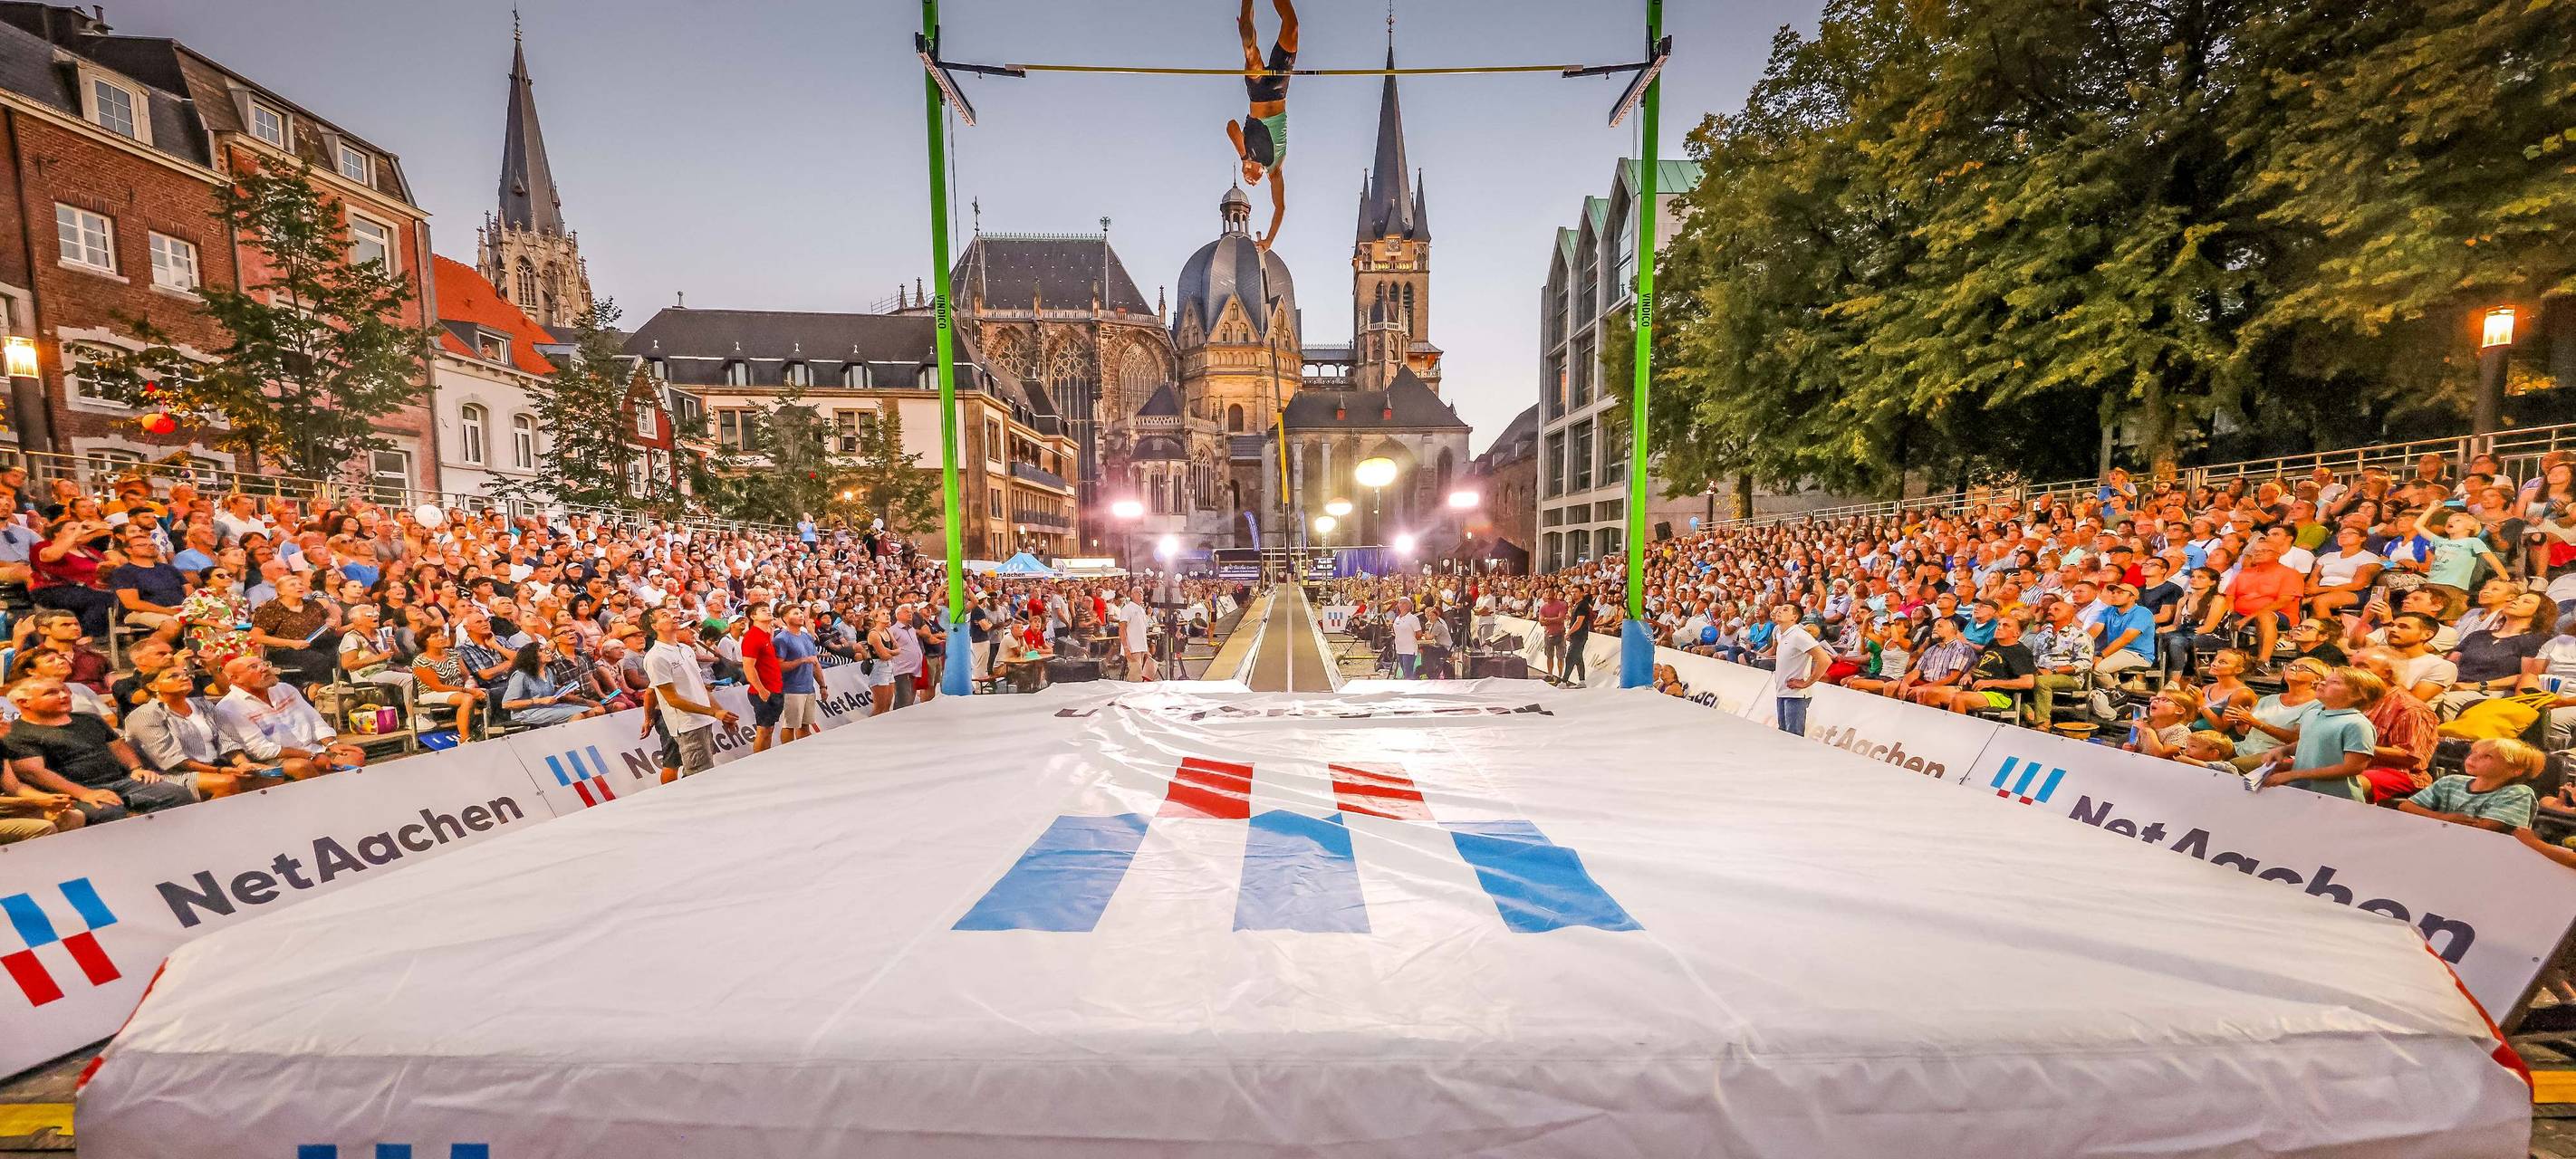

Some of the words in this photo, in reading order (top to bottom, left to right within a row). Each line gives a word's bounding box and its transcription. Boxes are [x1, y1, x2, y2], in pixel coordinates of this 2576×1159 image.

[937, 294, 947, 330] VINDICO
[1642, 292, 1651, 327] VINDICO
[816, 691, 874, 718] NetAac
[1809, 725, 1946, 780] etAachen
[156, 796, 525, 929] NetAachen
